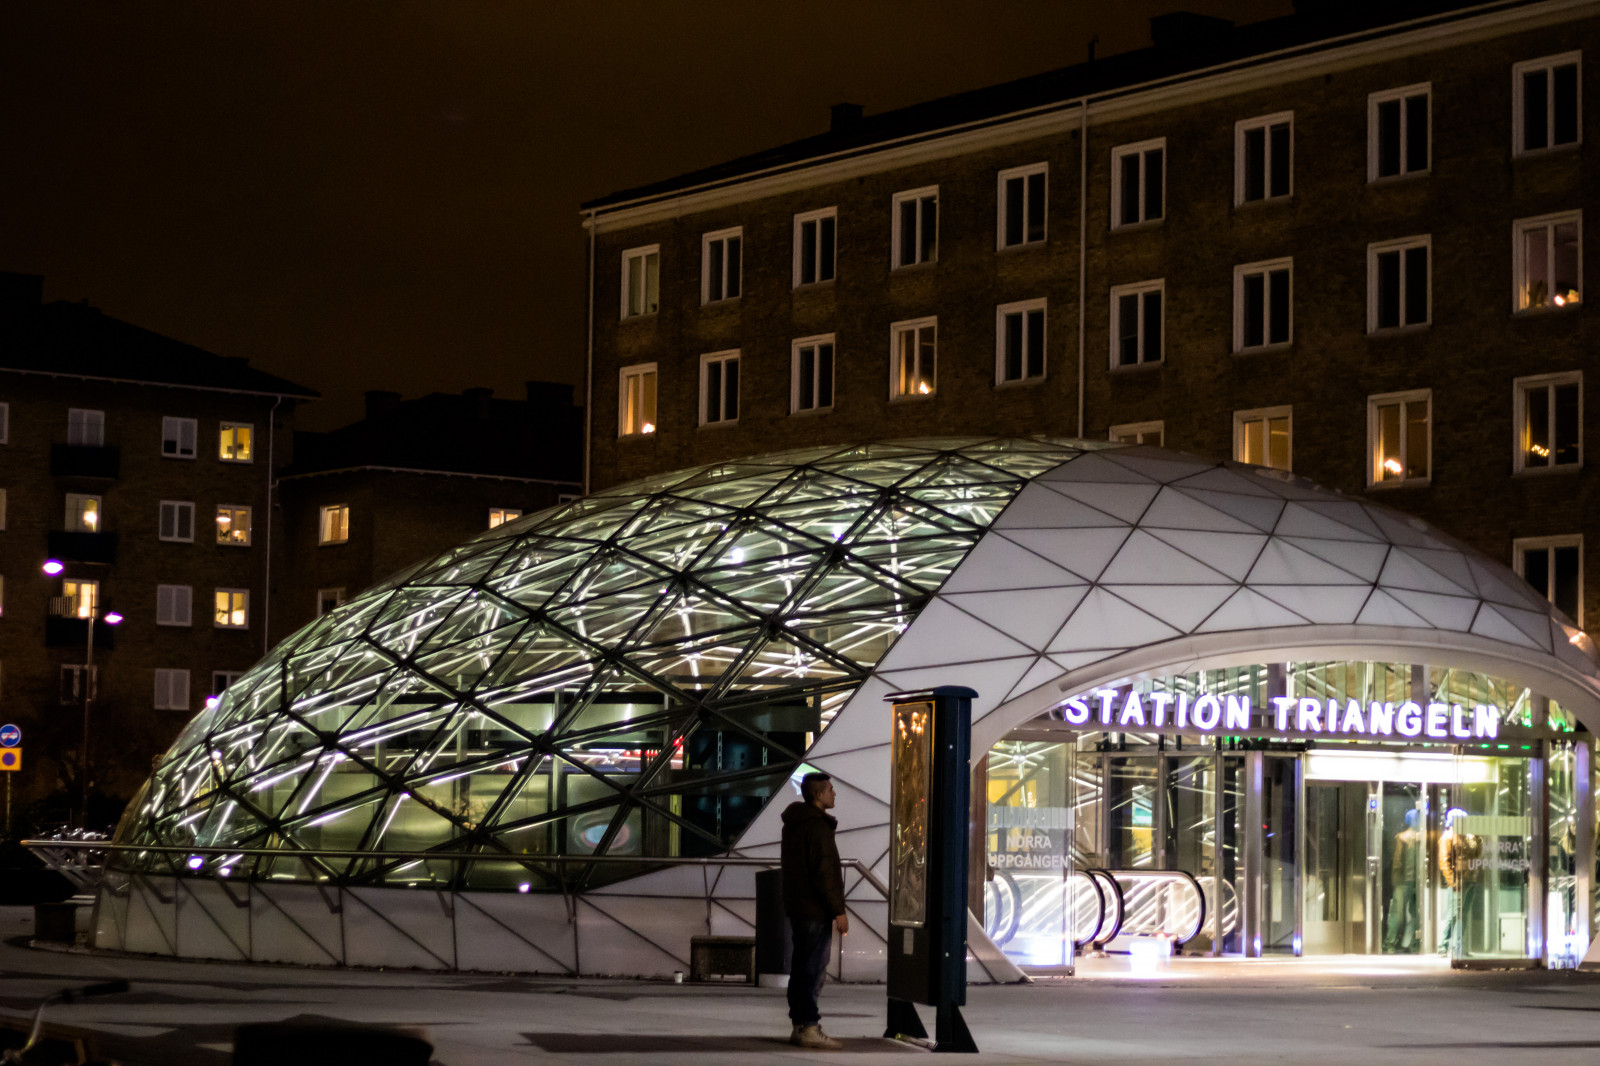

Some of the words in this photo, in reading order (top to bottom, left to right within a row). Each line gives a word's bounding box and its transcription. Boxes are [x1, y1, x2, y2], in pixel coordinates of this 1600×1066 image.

[1064, 688, 1251, 731] STATION
[1273, 696, 1499, 739] TRIANGELN
[1006, 835, 1052, 849] NORRA
[1482, 841, 1519, 853] NRRA
